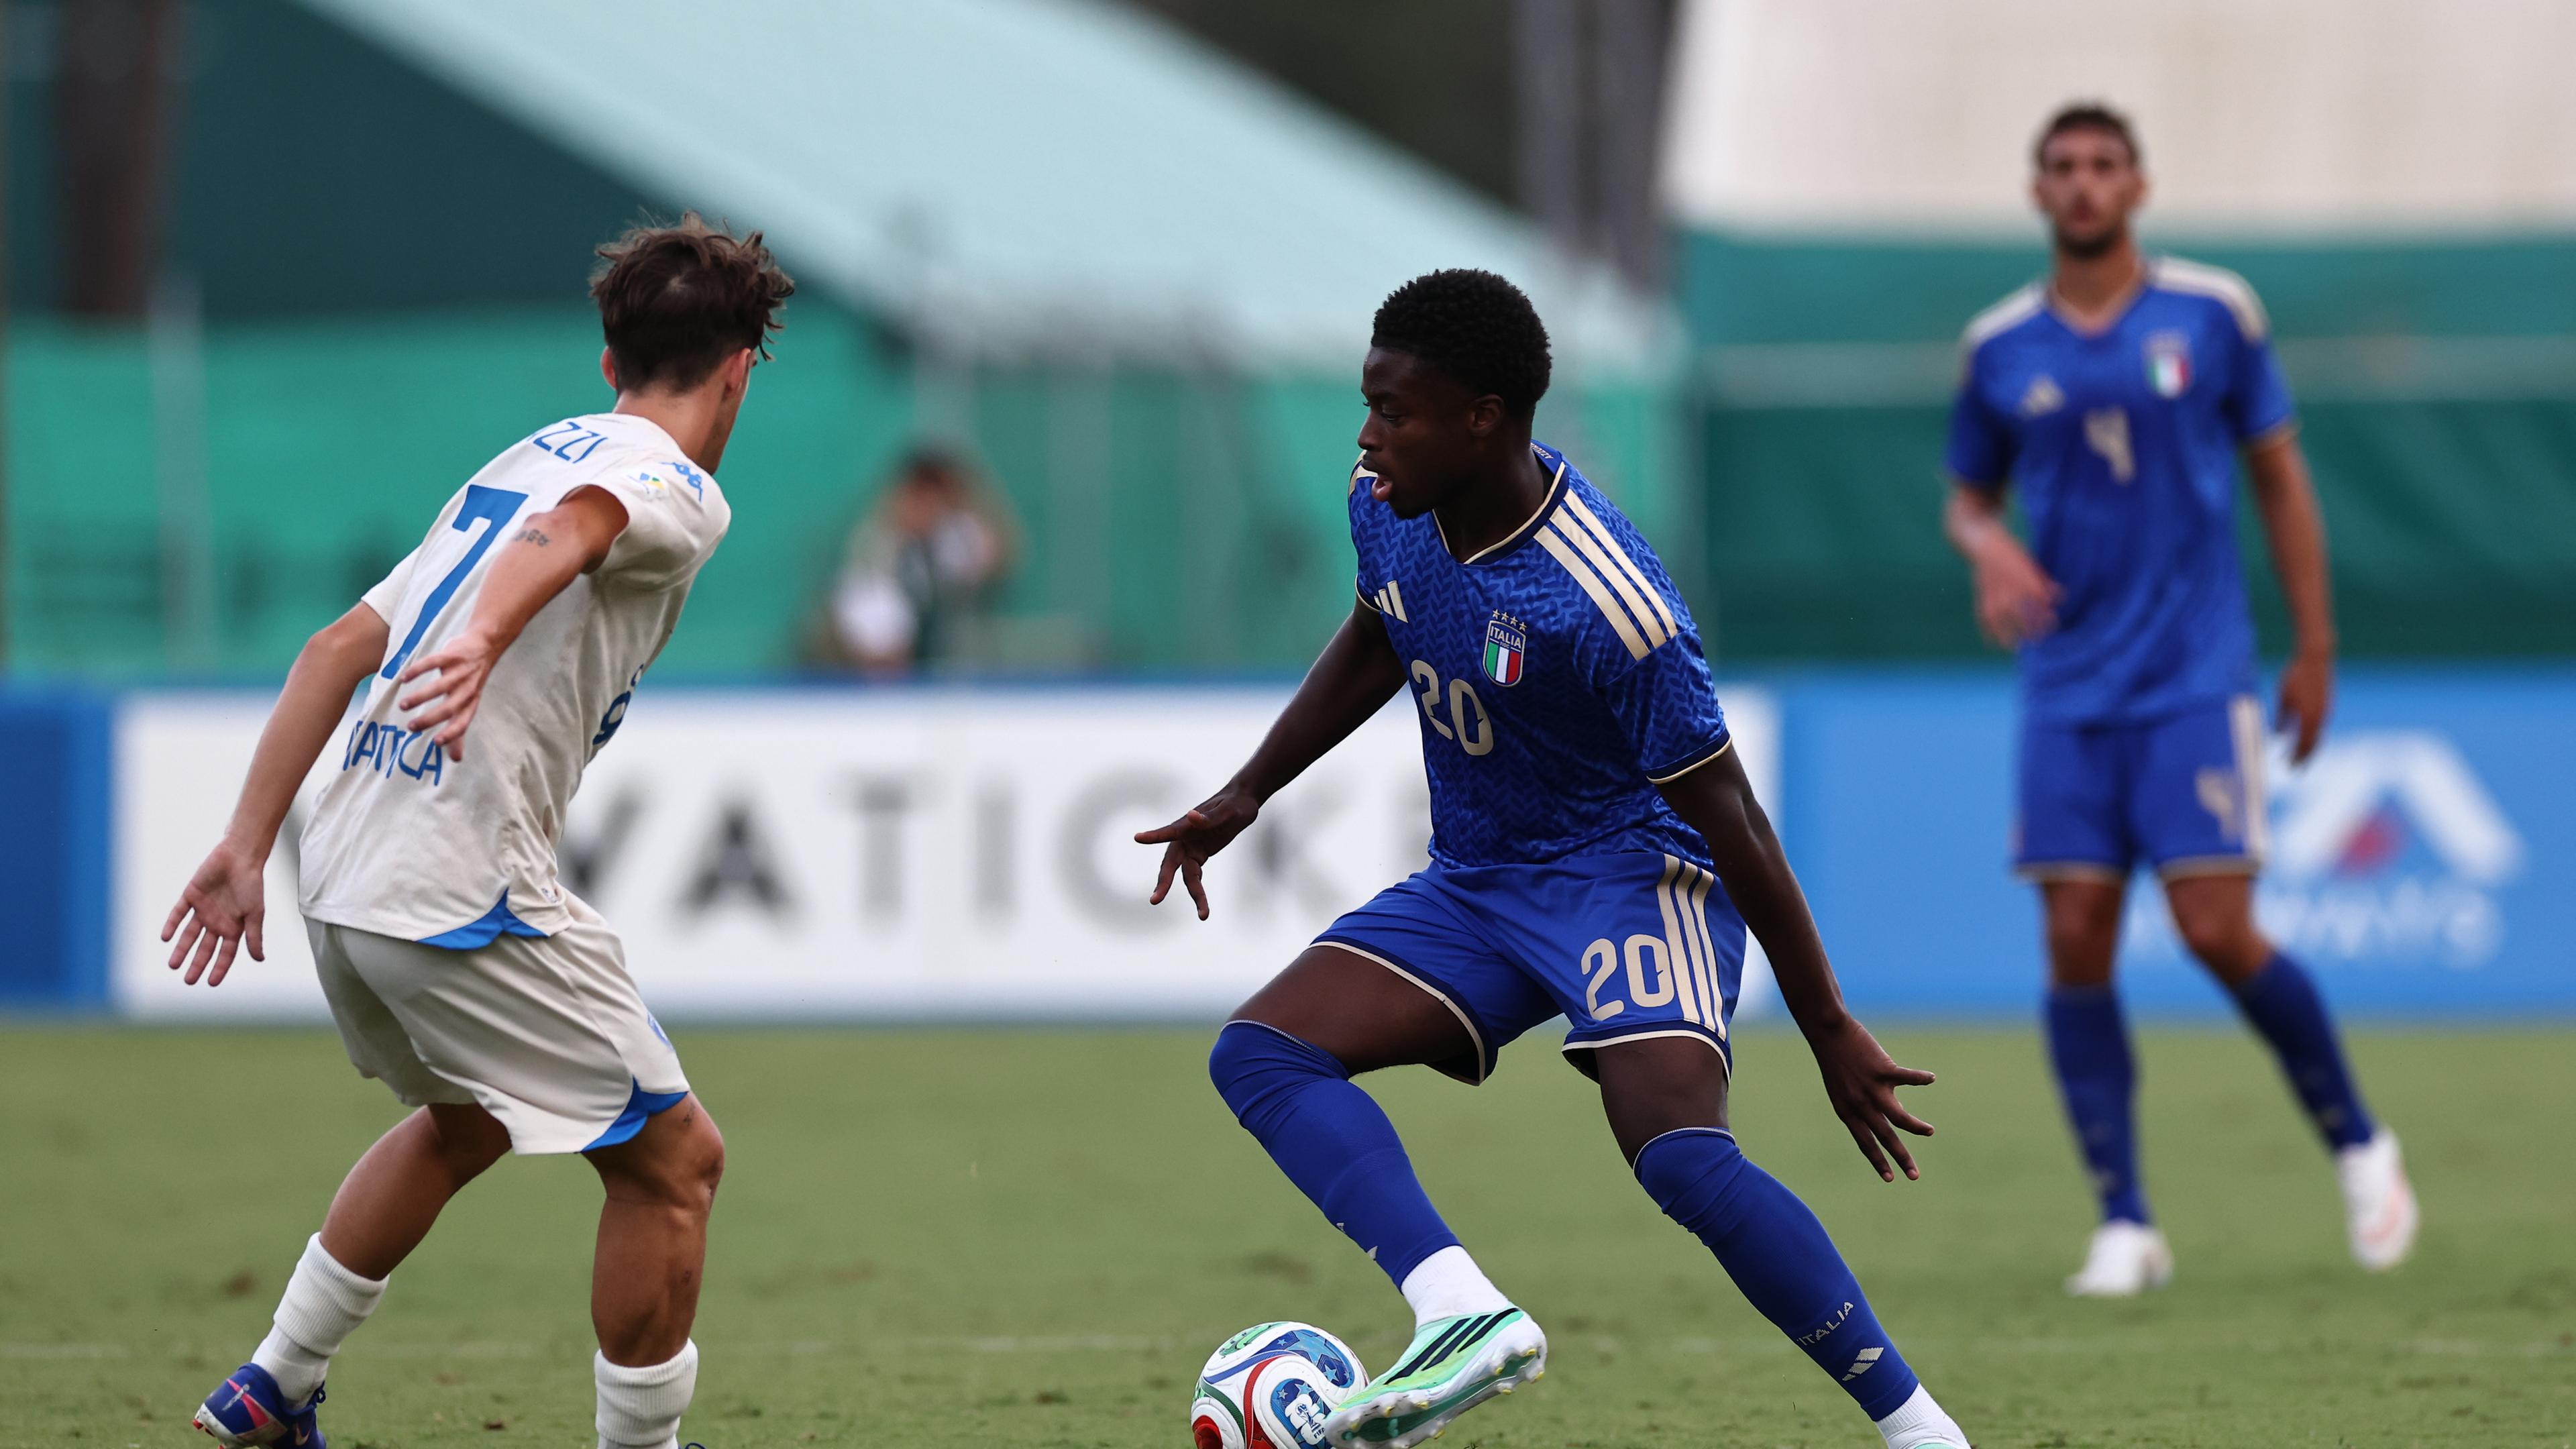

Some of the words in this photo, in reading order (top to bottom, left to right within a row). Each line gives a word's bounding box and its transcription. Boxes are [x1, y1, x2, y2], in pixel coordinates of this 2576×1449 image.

[532, 421, 608, 464] ZZI
[381, 484, 529, 680] 7
[1490, 625, 1521, 649] ITALIA
[1411, 659, 1494, 755] 20
[1581, 934, 1674, 1021] 20
[1798, 1301, 1854, 1346] ITALIA
